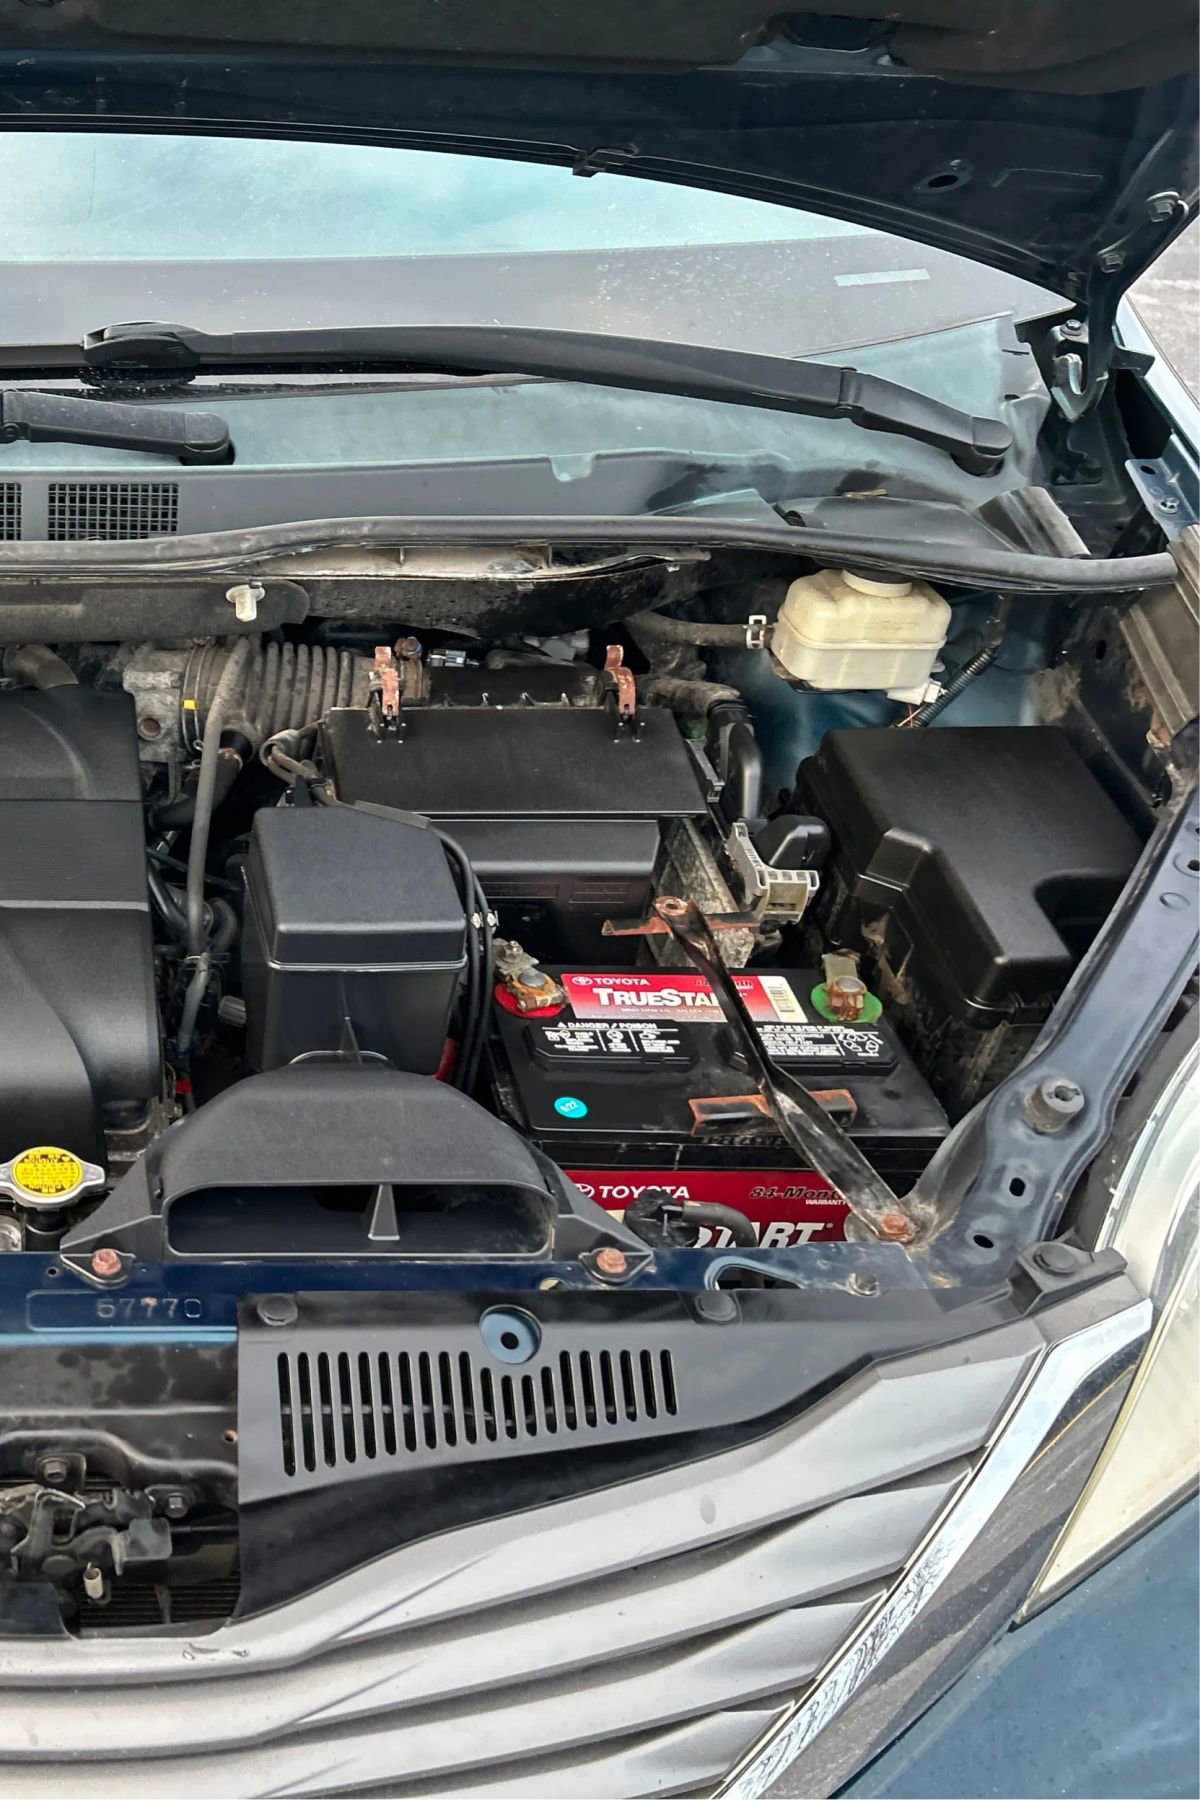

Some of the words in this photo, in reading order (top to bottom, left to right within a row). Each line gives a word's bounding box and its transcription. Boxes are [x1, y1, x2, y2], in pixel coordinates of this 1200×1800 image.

[593, 977, 651, 986] TOYOTA
[599, 1185, 690, 1199] TOYTA
[96, 1297, 202, 1318] 57770
